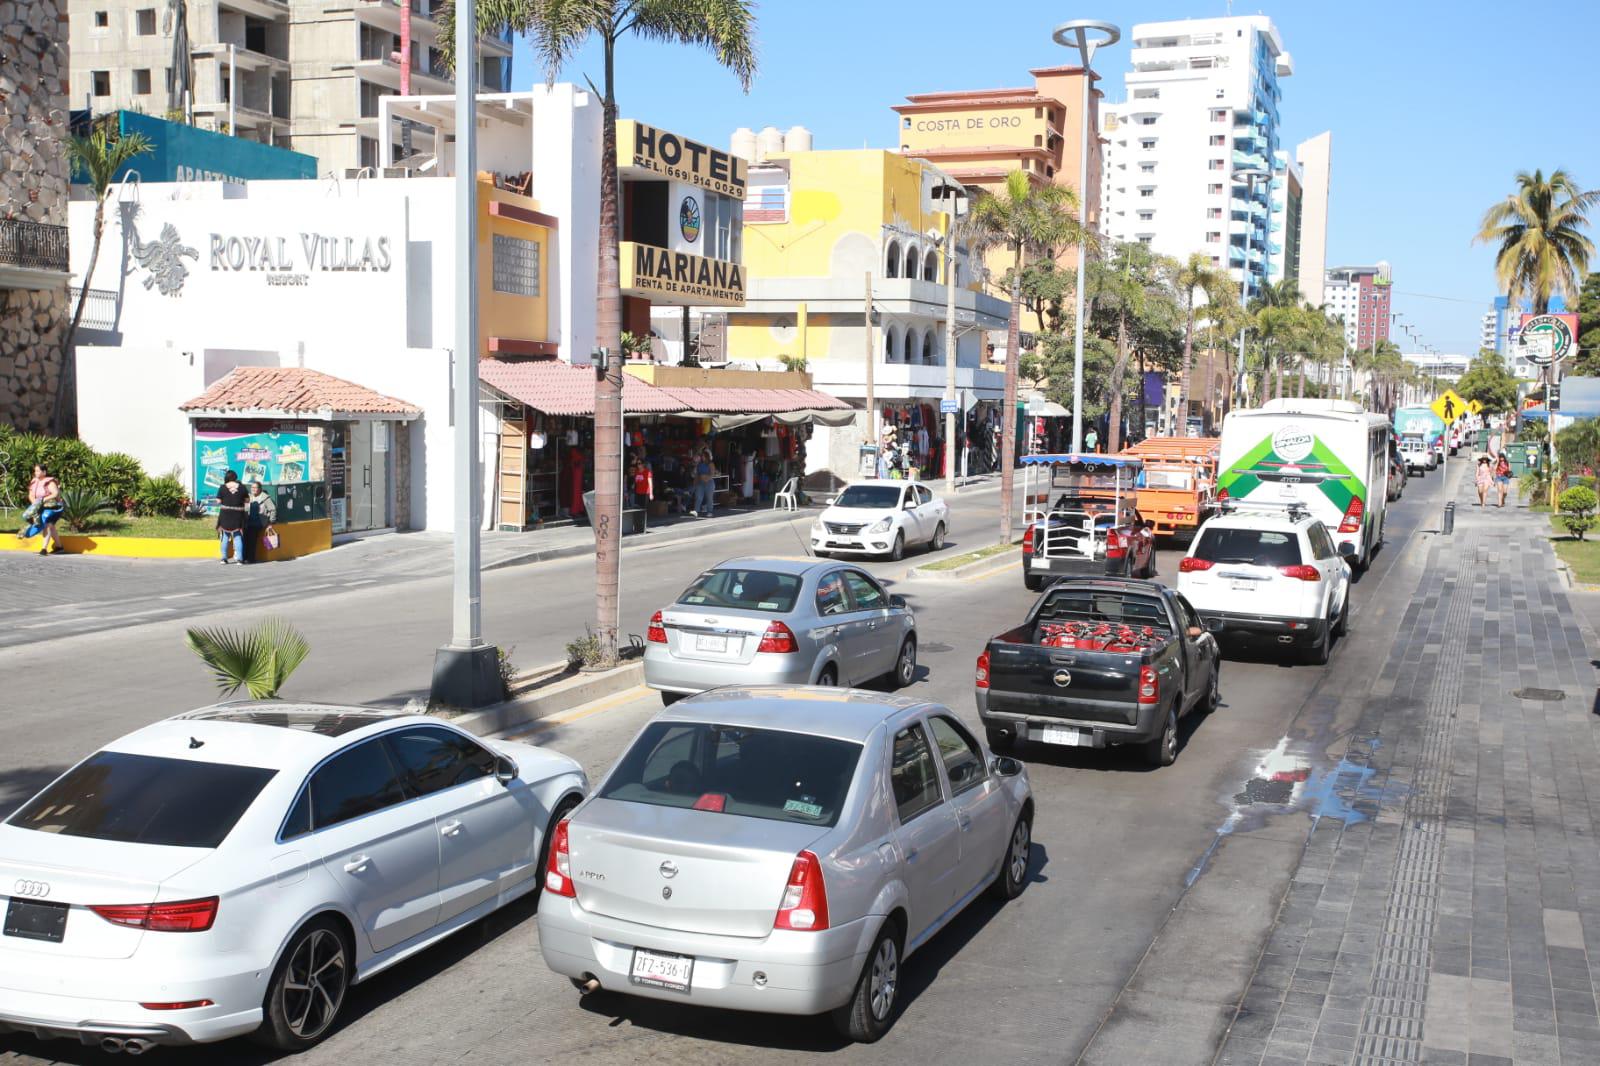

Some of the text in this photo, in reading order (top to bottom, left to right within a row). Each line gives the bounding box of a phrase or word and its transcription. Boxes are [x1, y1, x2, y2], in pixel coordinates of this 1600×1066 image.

[917, 116, 1021, 132] COSTA DE ORO
[635, 123, 745, 188] HOTEL
[664, 166, 691, 184] (669)
[693, 175, 711, 188] 914
[714, 181, 743, 197] 0029
[209, 232, 392, 272] ROYAL VILLAS
[266, 274, 309, 286] RESORT
[636, 245, 743, 292] MARIANA
[635, 277, 744, 302] RENTA DE APARTAMENTOS
